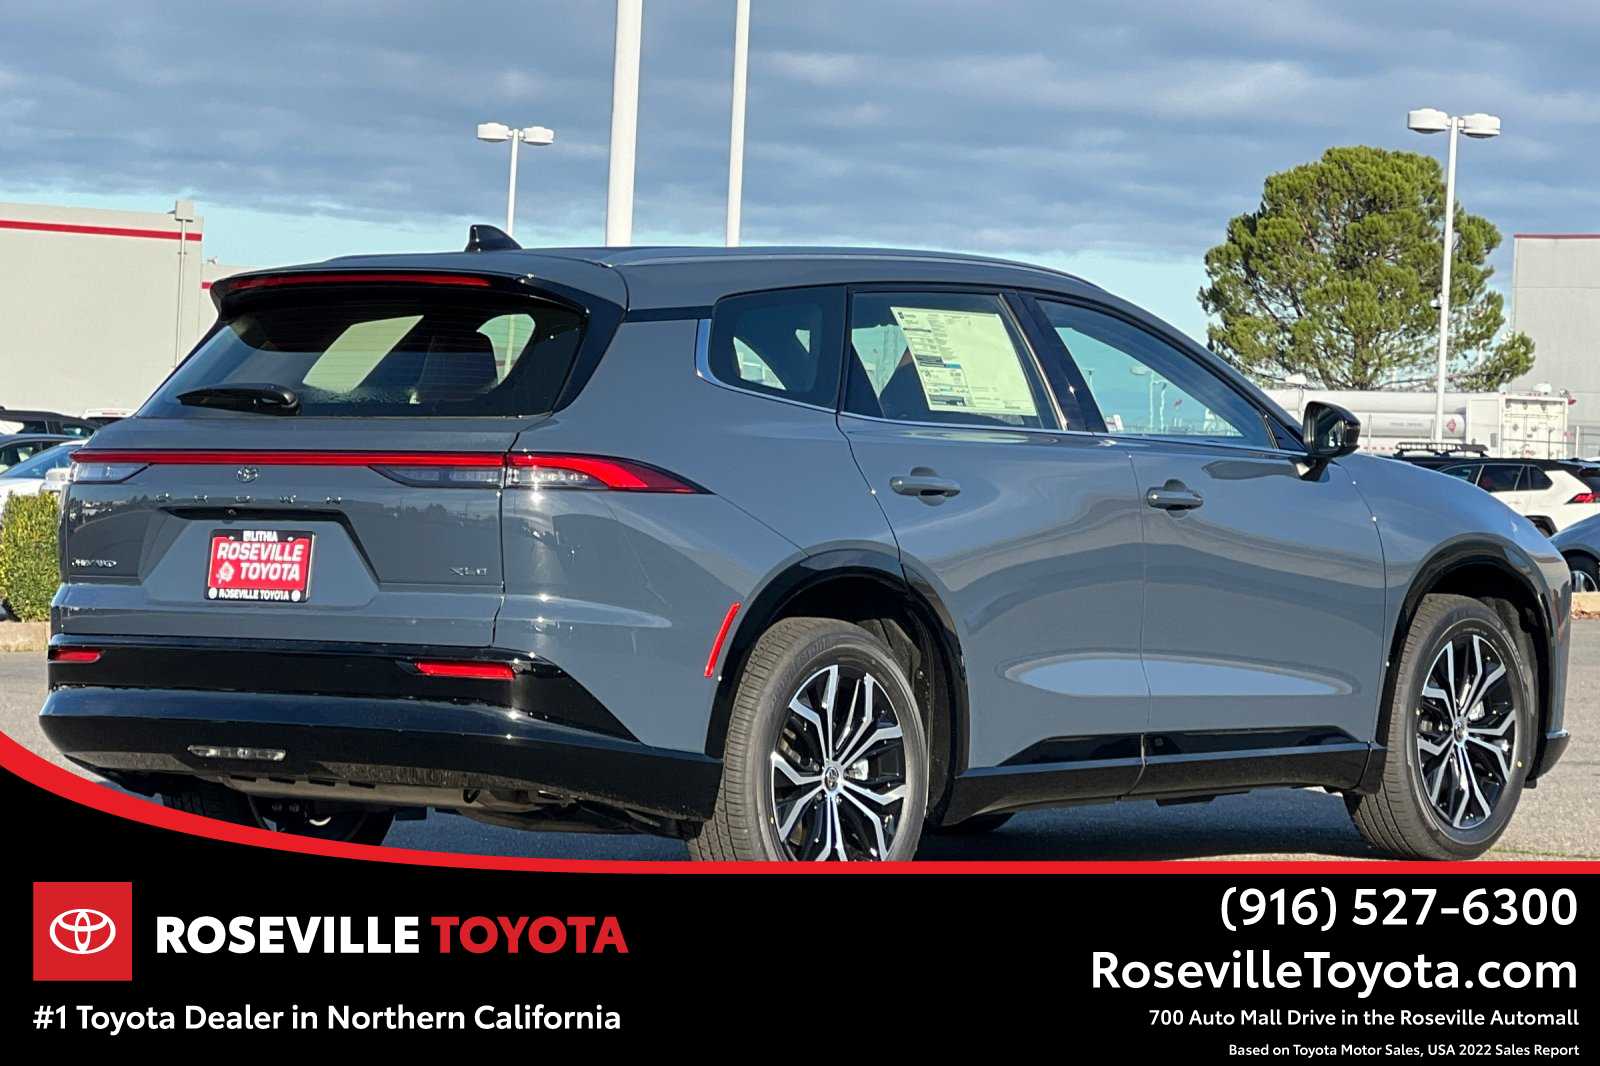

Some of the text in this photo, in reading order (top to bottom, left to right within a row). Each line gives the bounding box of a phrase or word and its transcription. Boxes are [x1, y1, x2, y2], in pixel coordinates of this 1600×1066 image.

[217, 543, 304, 561] ROSEVILLE
[240, 562, 300, 581] TOYOTA
[218, 589, 289, 600] ROSEVILLE TOYOTA
